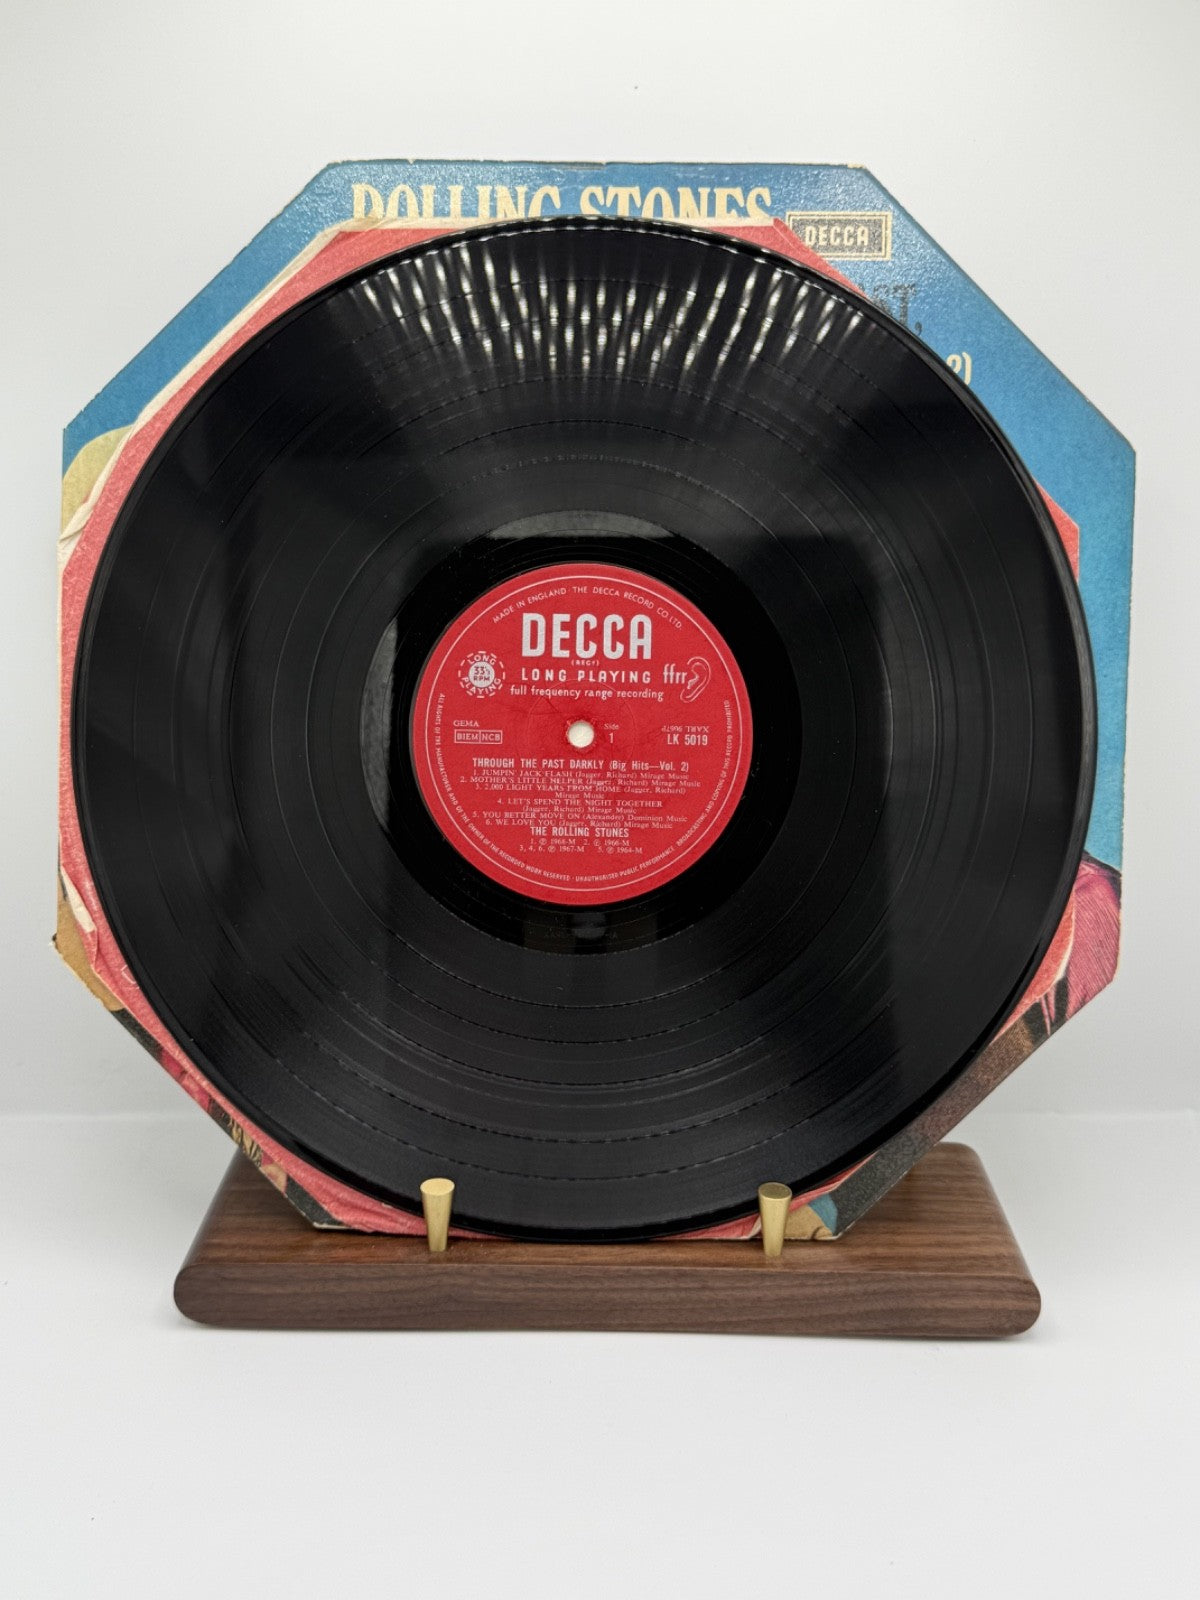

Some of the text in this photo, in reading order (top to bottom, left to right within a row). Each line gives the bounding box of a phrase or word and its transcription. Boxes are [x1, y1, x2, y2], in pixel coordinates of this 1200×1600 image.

[804, 224, 870, 247] DECCA
[491, 605, 514, 623] MADE
[515, 599, 525, 608] IN
[527, 587, 566, 603] ENGLAND
[592, 587, 620, 597] DECCA
[623, 592, 653, 610] RECORD
[521, 612, 652, 660] DECCA
[467, 654, 496, 665] LONG
[522, 667, 651, 683] LONG PLAYING
[663, 663, 687, 684] ffrr
[461, 677, 501, 694] PLAYING
[510, 684, 664, 702] full frequency range recording
[435, 704, 443, 724] RIGHTS
[456, 733, 501, 741] BIEM NCB
[608, 732, 614, 744] 1
[667, 733, 708, 746] LK 5019
[436, 747, 452, 792] MANUFACTURER
[472, 758, 514, 767] THROUGH
[521, 758, 537, 768] THE
[542, 759, 564, 769] PAST
[570, 759, 604, 770] DARKLY
[610, 761, 626, 771] (Big
[681, 761, 688, 772] 2)
[711, 778, 724, 800] COPYING
[448, 792, 458, 805] AND
[455, 805, 463, 813] OF
[704, 800, 714, 813] AND
[461, 813, 469, 822] THE
[467, 822, 484, 840] OWNER
[530, 826, 547, 836] THE
[552, 827, 589, 836] ROLLING
[676, 812, 707, 847] BROADCASTING
[482, 837, 490, 845] OF
[489, 843, 499, 852] THE
[498, 849, 525, 868] RECORDED
[639, 845, 674, 869] PERFORMANCE
[525, 864, 541, 874] WORK
[542, 870, 570, 880] RESERVED
[619, 865, 639, 876] PUBLIC
